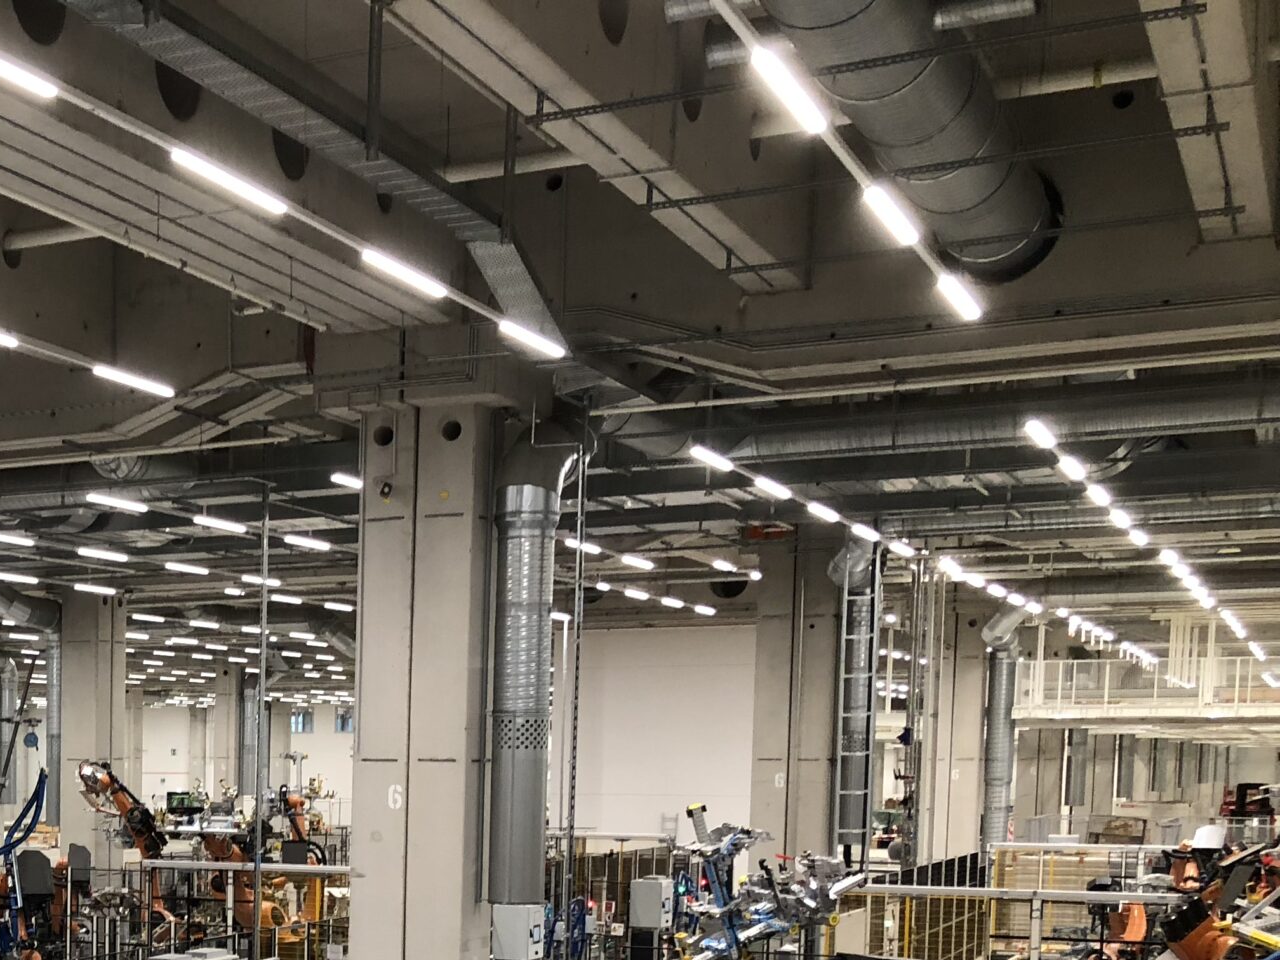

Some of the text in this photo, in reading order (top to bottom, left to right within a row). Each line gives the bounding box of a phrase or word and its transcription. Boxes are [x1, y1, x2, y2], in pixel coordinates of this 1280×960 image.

[774, 773, 785, 788] 6
[951, 769, 960, 780] 6
[388, 784, 402, 809] 6
